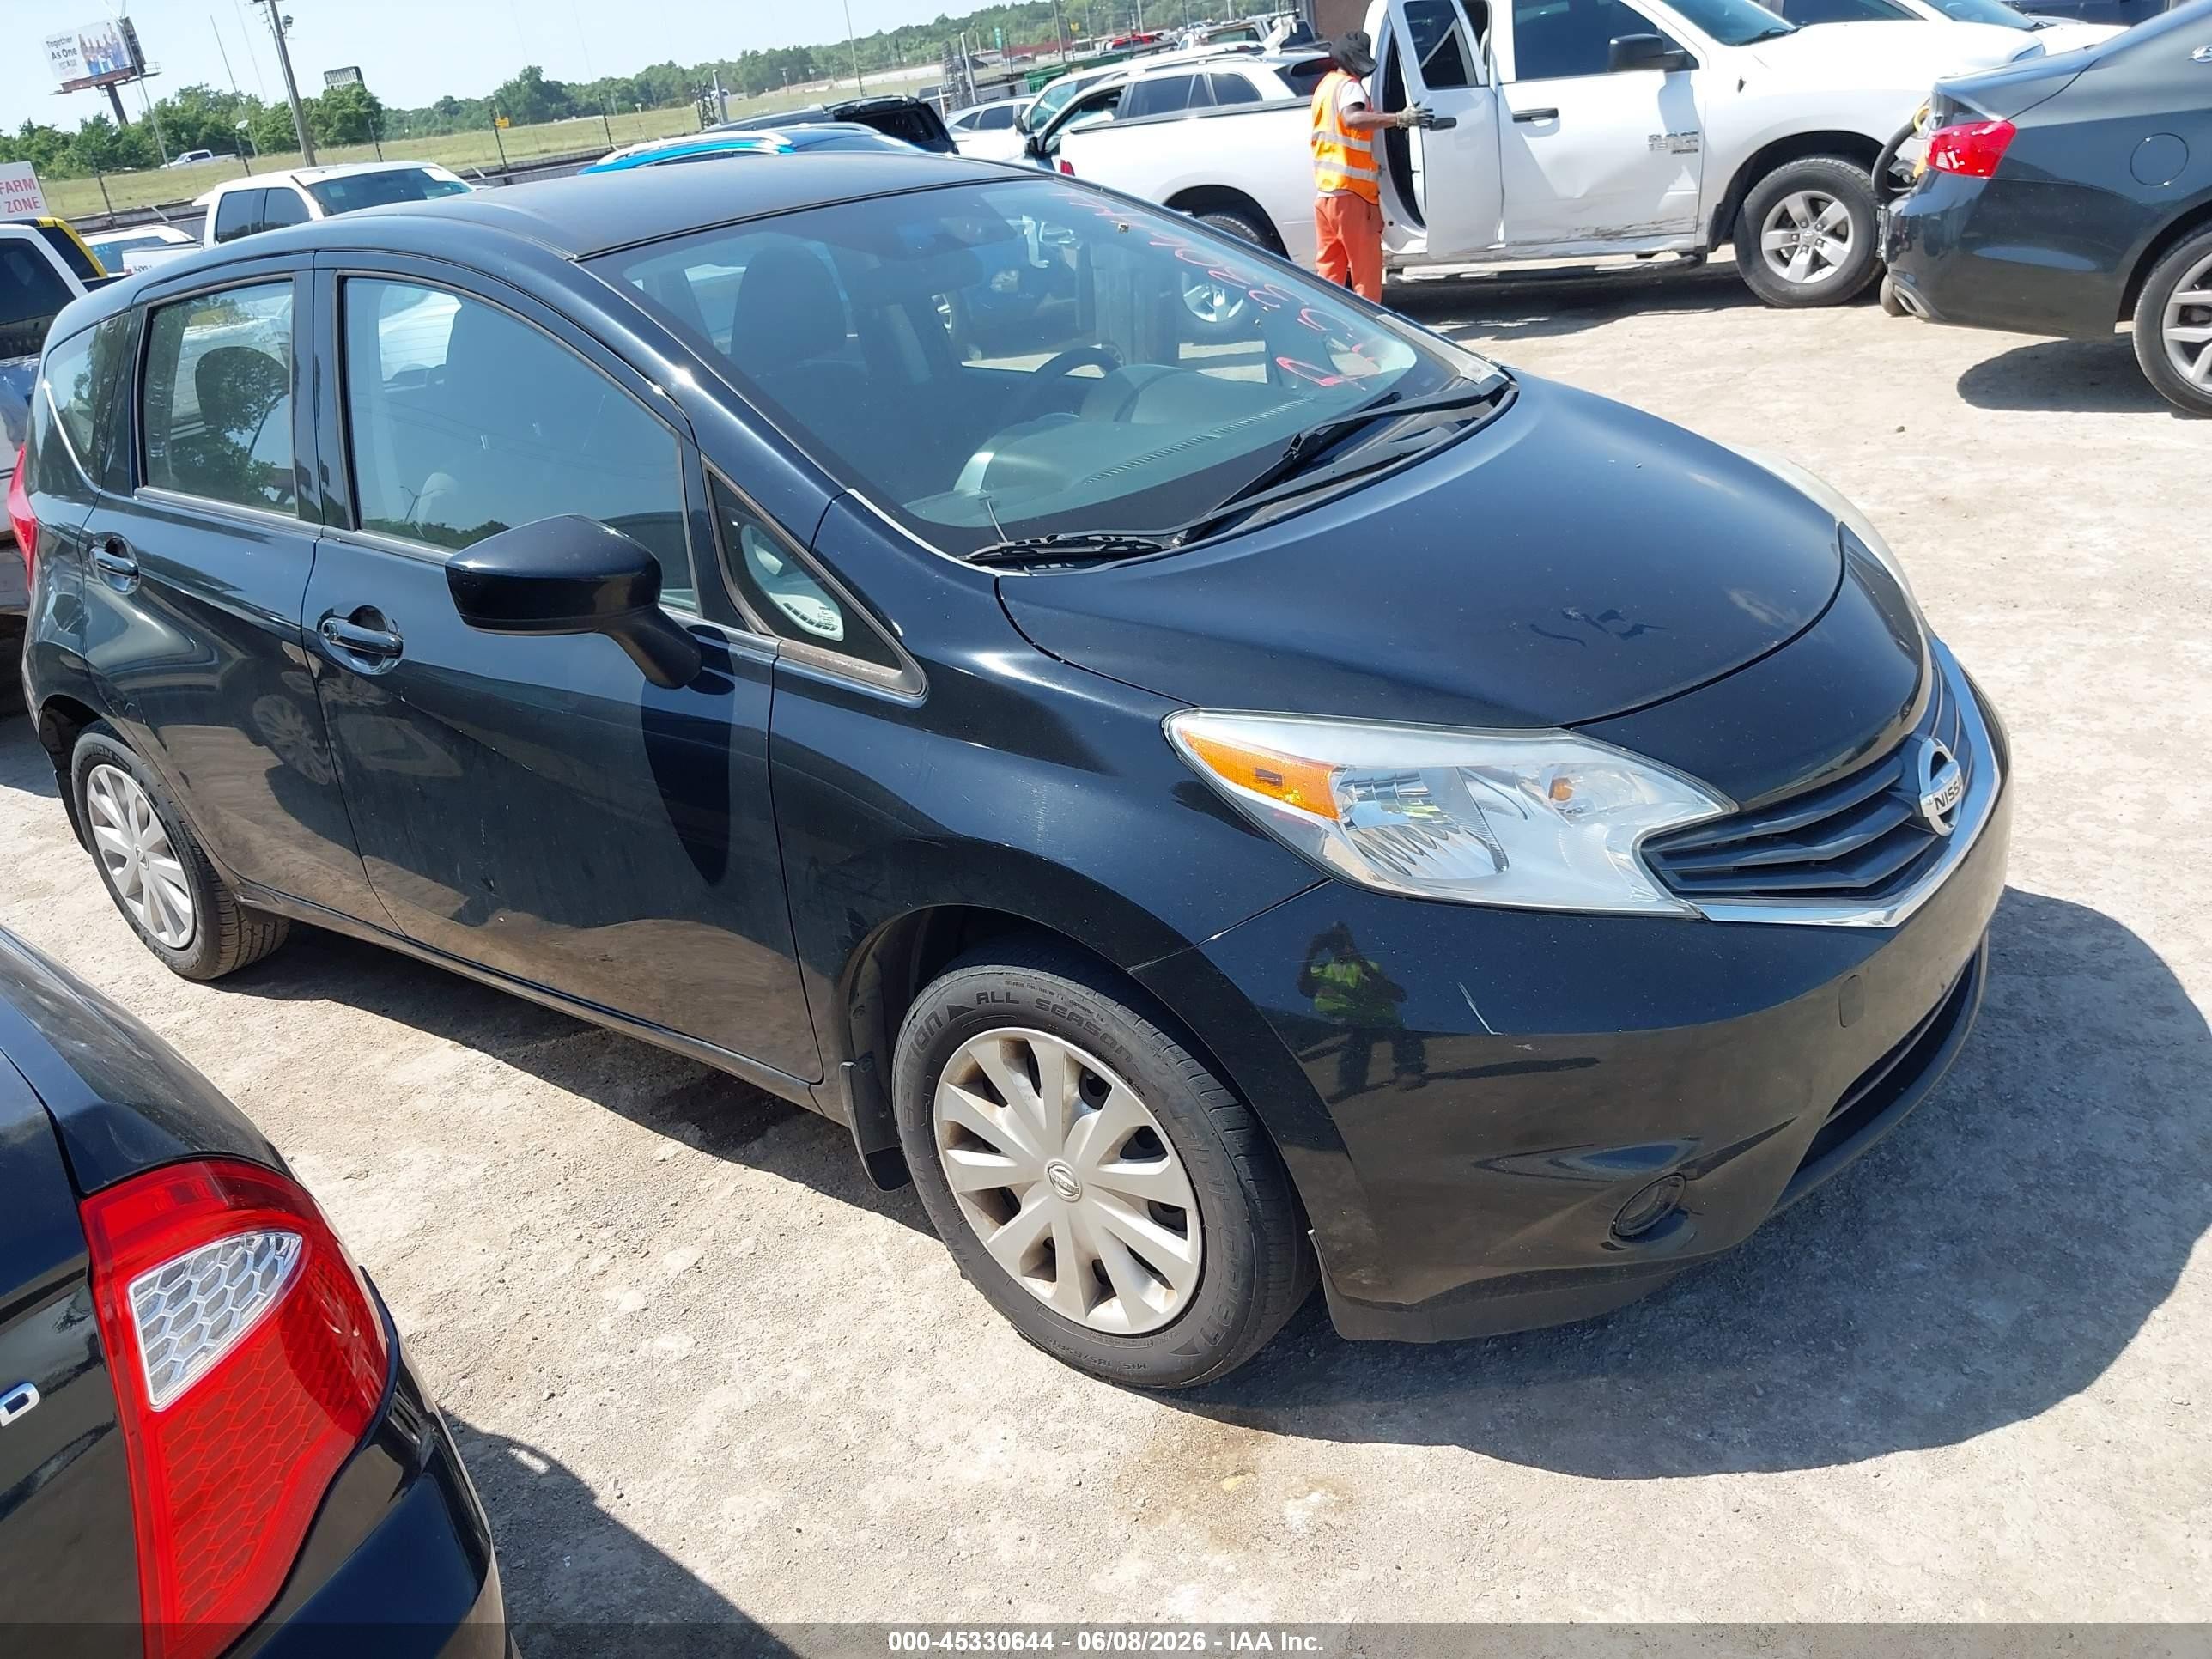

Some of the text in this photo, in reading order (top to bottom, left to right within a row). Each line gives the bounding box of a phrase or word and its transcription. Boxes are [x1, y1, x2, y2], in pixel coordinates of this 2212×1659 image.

[46, 36, 73, 49] Together
[52, 47, 77, 60] As One
[4, 197, 41, 213] ZONE
[1933, 775, 1962, 811] NISS
[976, 991, 1020, 1005] ALL
[1035, 997, 1134, 1063] SEASON
